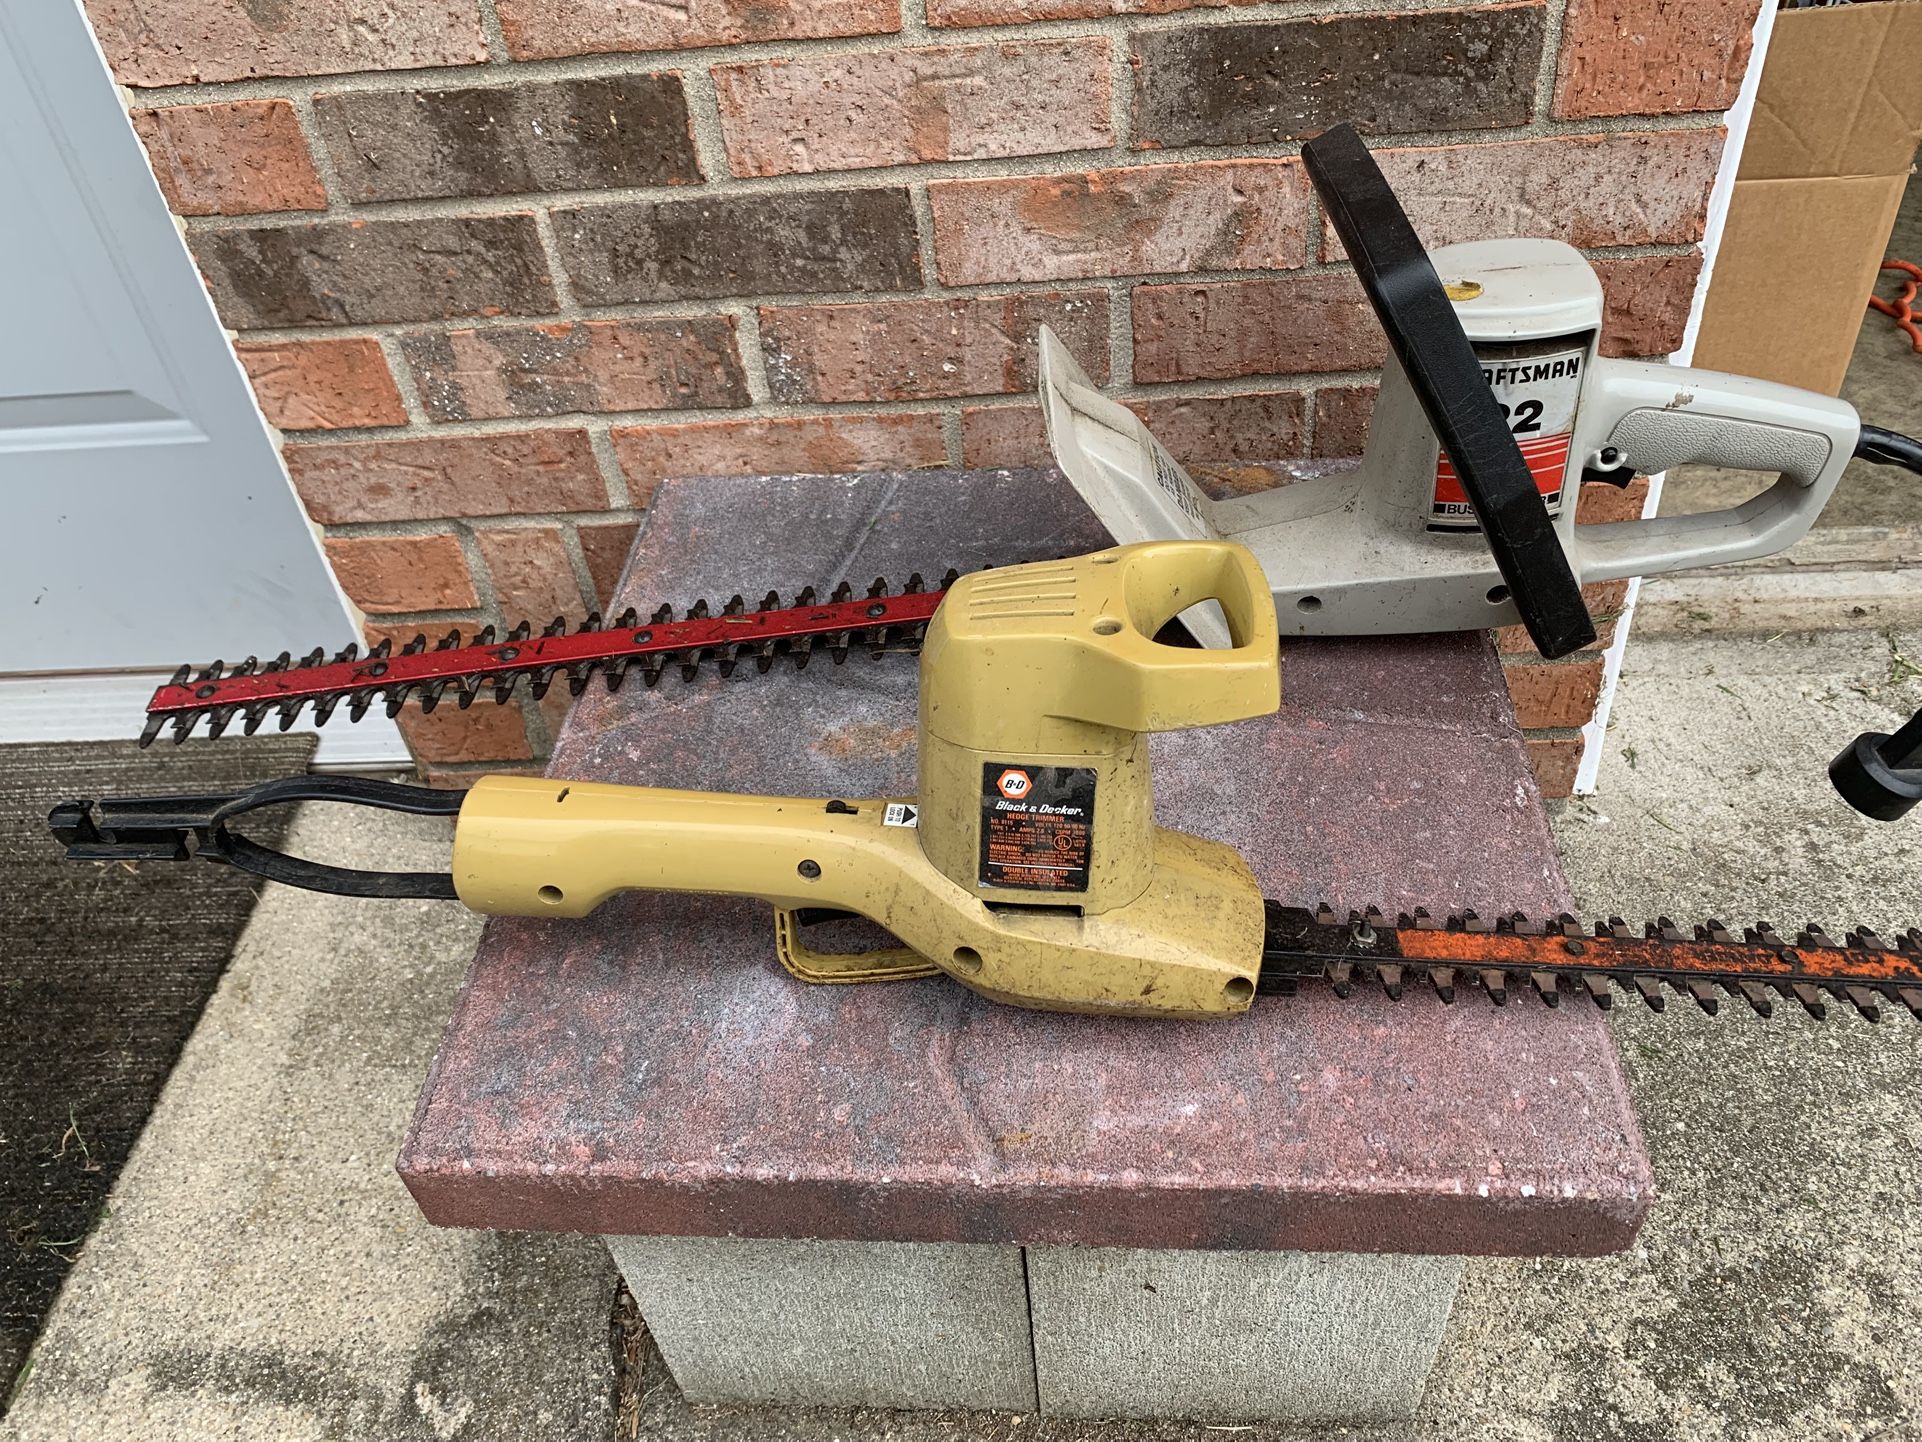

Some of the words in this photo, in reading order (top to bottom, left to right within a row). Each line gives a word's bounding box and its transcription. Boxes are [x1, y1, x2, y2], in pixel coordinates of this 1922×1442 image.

[1482, 357, 1580, 386] AFTSMAN
[1447, 503, 1475, 514] BUS
[996, 800, 1028, 812] Black
[1031, 814, 1065, 823] TRIMMER
[1031, 868, 1068, 876] INSULATED
